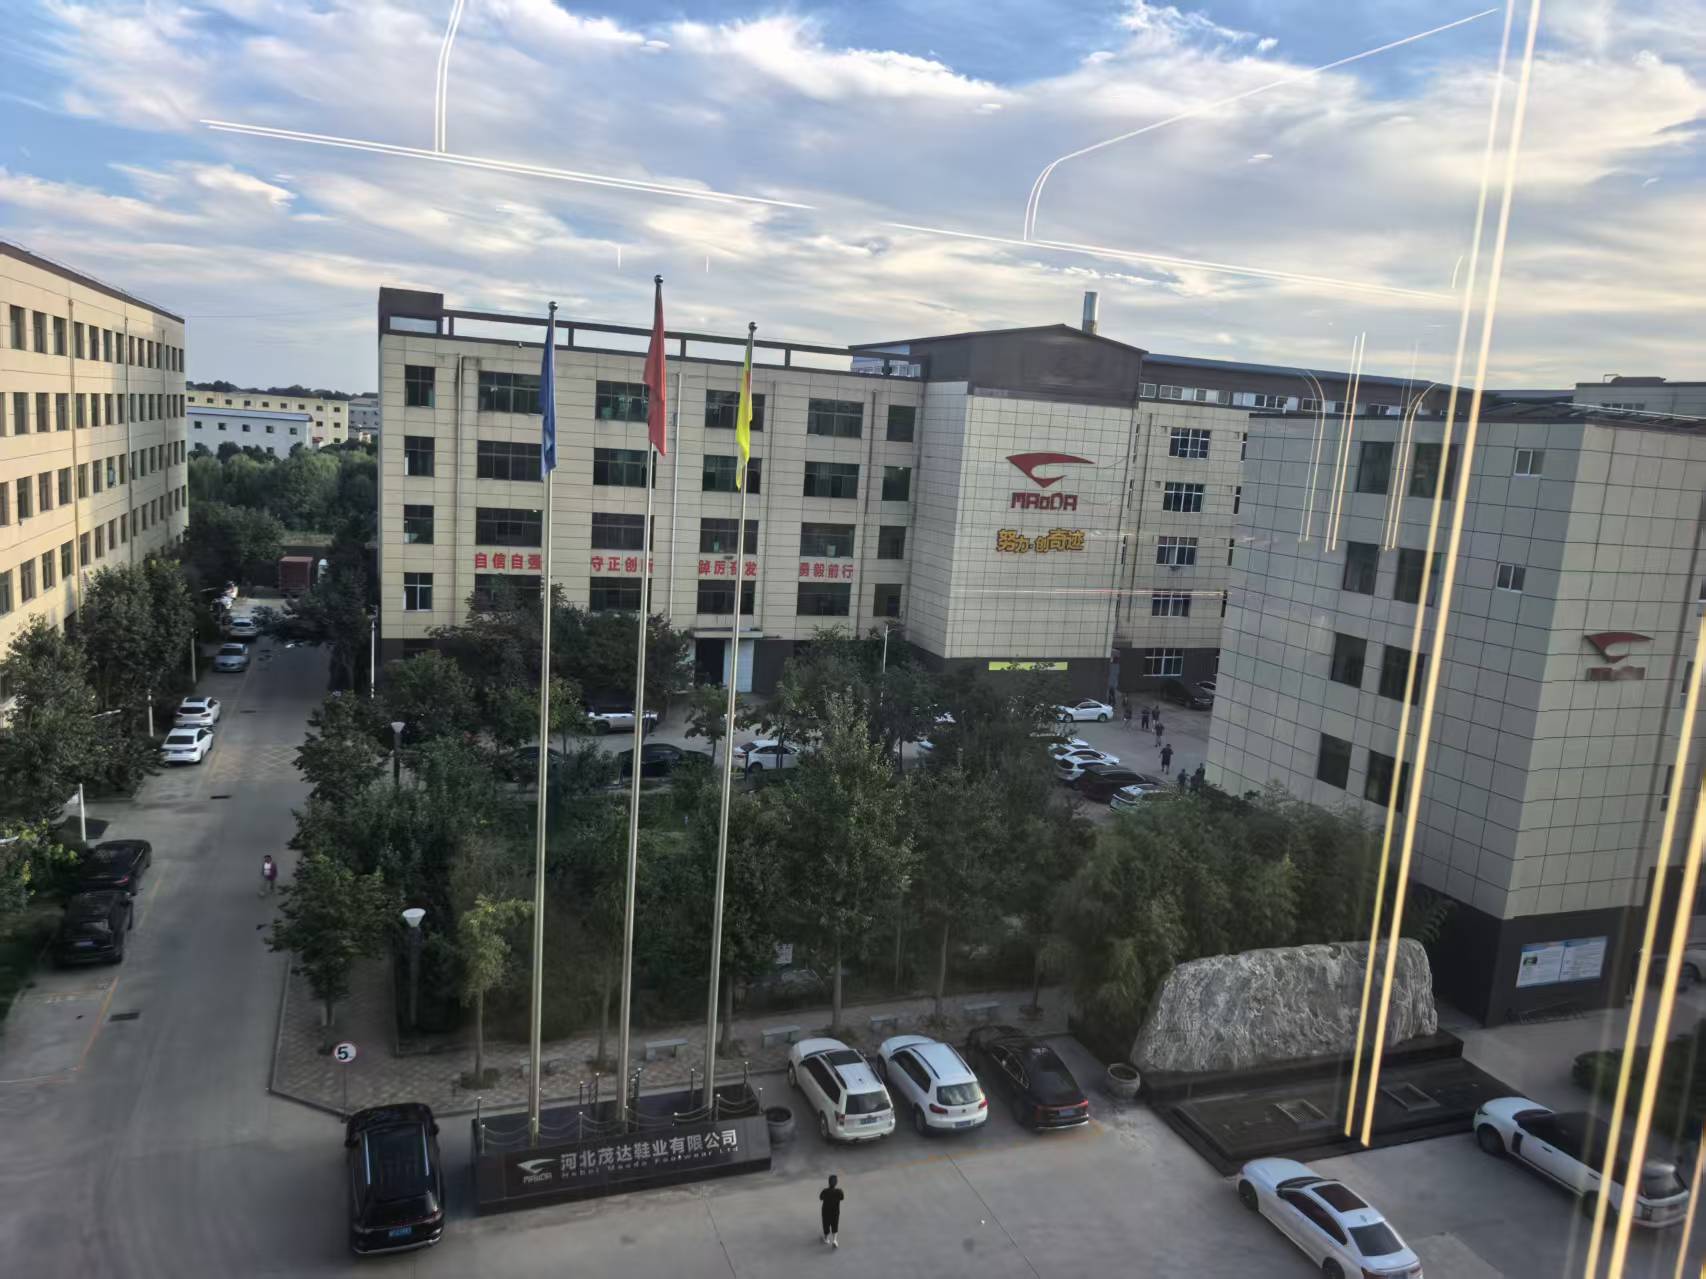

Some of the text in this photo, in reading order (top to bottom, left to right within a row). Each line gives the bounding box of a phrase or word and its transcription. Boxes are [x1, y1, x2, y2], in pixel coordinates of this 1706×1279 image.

[474, 552, 542, 570] 自信自强
[338, 1046, 349, 1060] 5
[561, 1129, 738, 1171] 河北茂达鞋业有限公司
